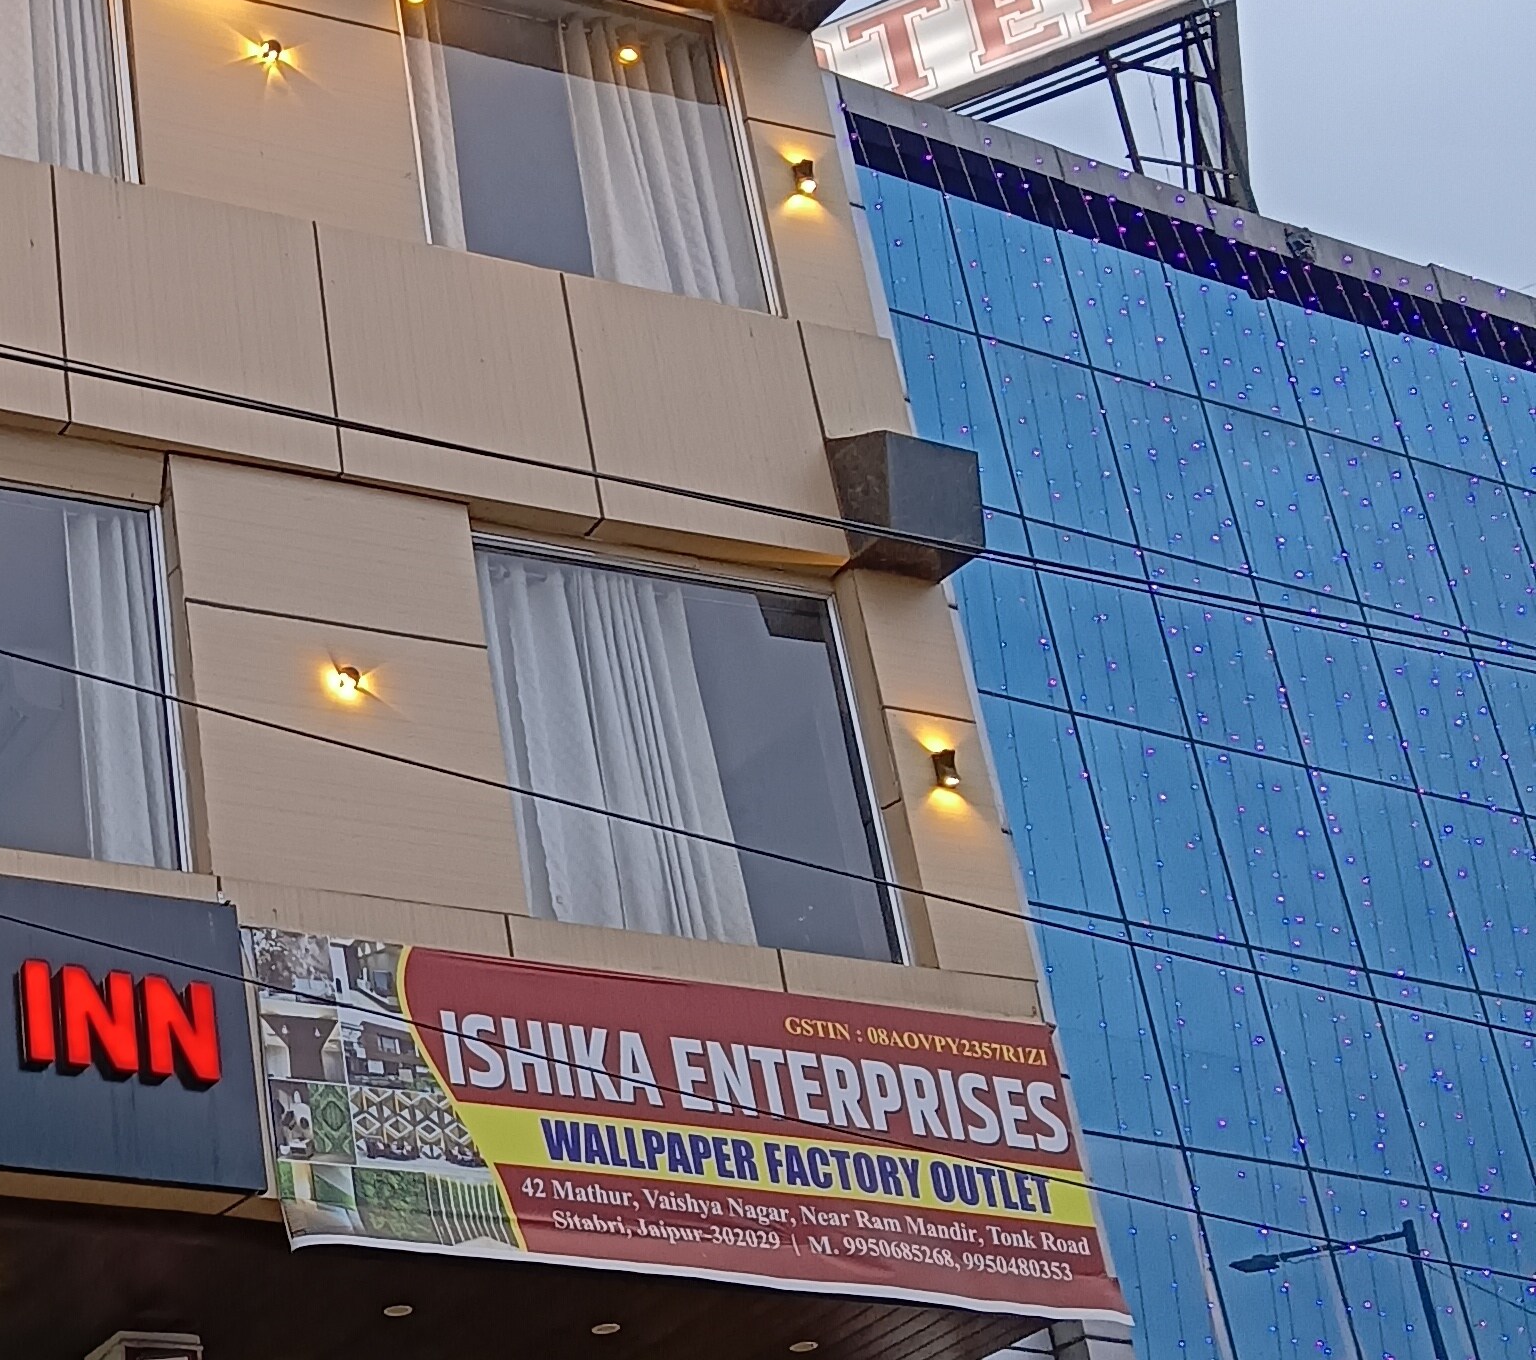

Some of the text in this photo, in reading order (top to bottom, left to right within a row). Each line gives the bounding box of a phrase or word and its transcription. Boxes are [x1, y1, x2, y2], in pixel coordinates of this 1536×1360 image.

[22, 960, 221, 1081] INN
[785, 1016, 851, 1041] GSTIN
[439, 1010, 1069, 1153] ISHIKA ENTERPRISES
[540, 1118, 1052, 1215] WALLPAPER FACTORY OUTLET
[521, 1177, 1091, 1256] 42 Mathur, Vaishya Nagar, Near Ram Mandir, Tonk Road
[551, 1209, 632, 1239] Sitabri,
[636, 1217, 781, 1250] Jaipur-302029
[808, 1235, 839, 1256] M.
